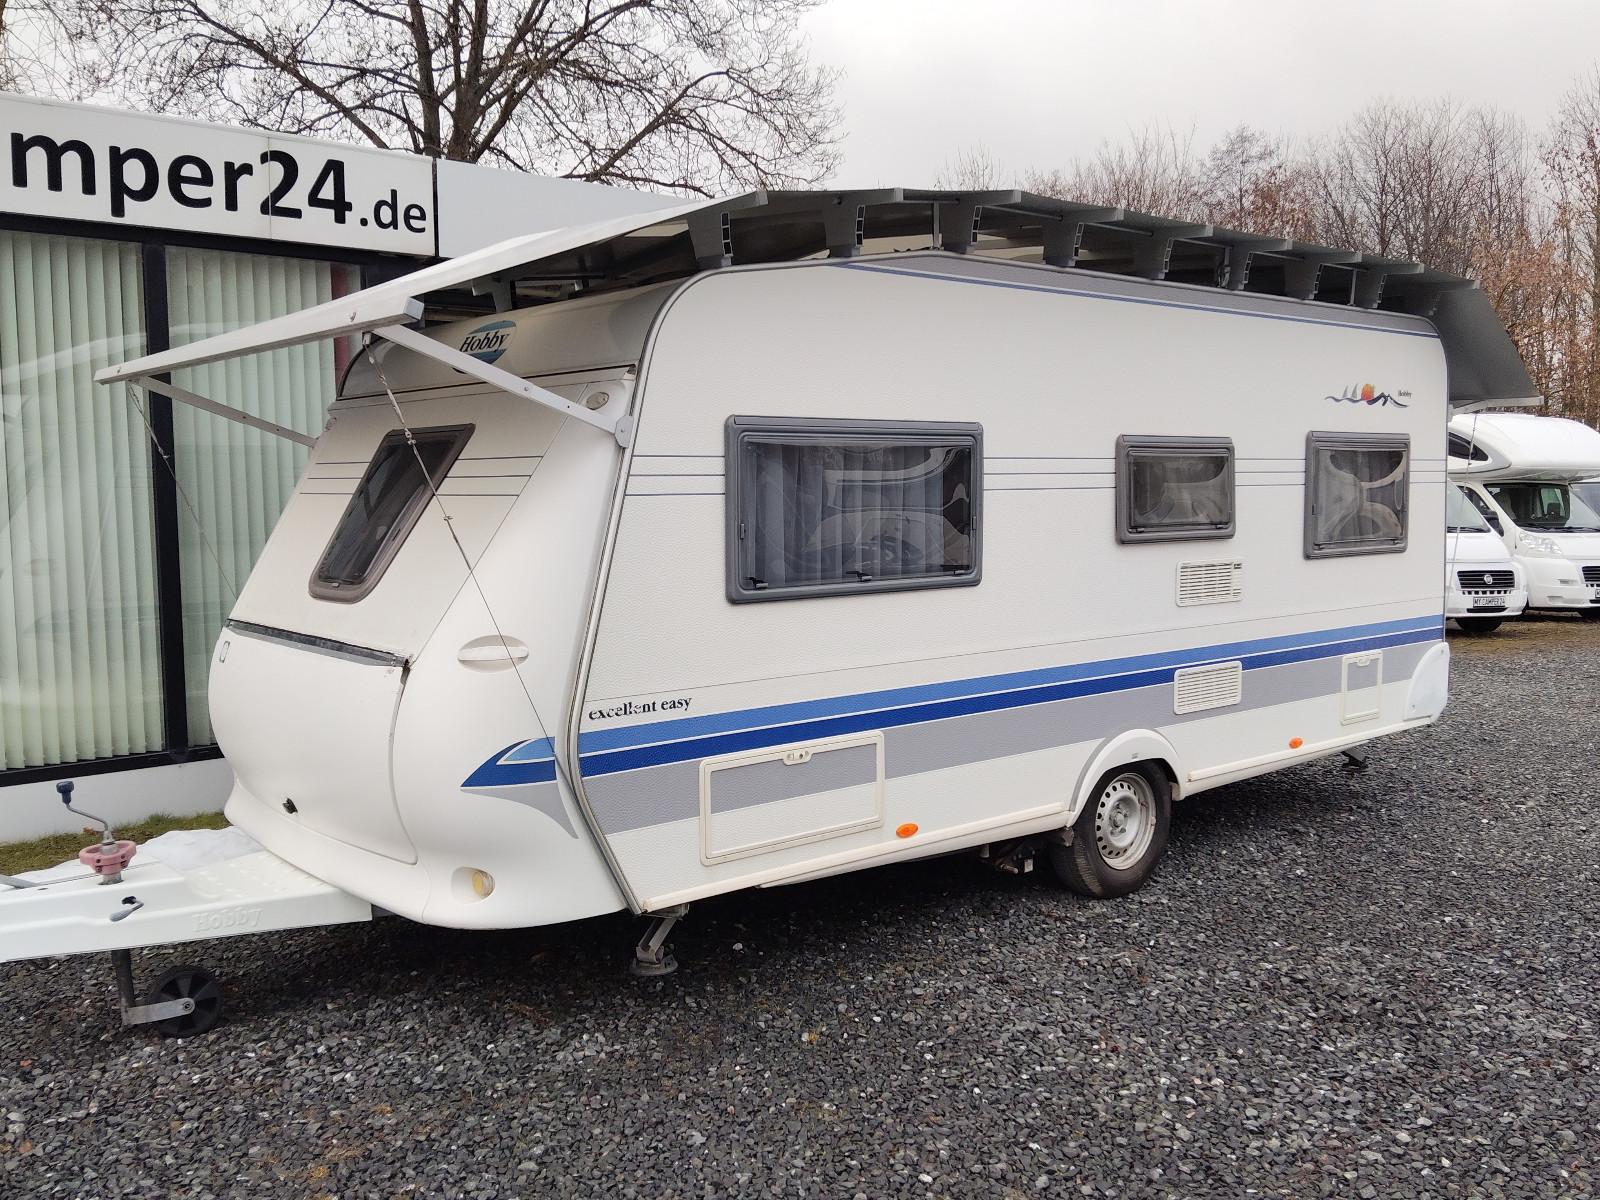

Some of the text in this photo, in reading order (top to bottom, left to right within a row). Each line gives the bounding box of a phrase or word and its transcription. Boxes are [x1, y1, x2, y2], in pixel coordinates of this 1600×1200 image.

[10, 132, 428, 234] mper24.de
[459, 330, 510, 353] Hobby
[588, 697, 692, 720] excellent easy
[191, 906, 264, 933] Hobby
